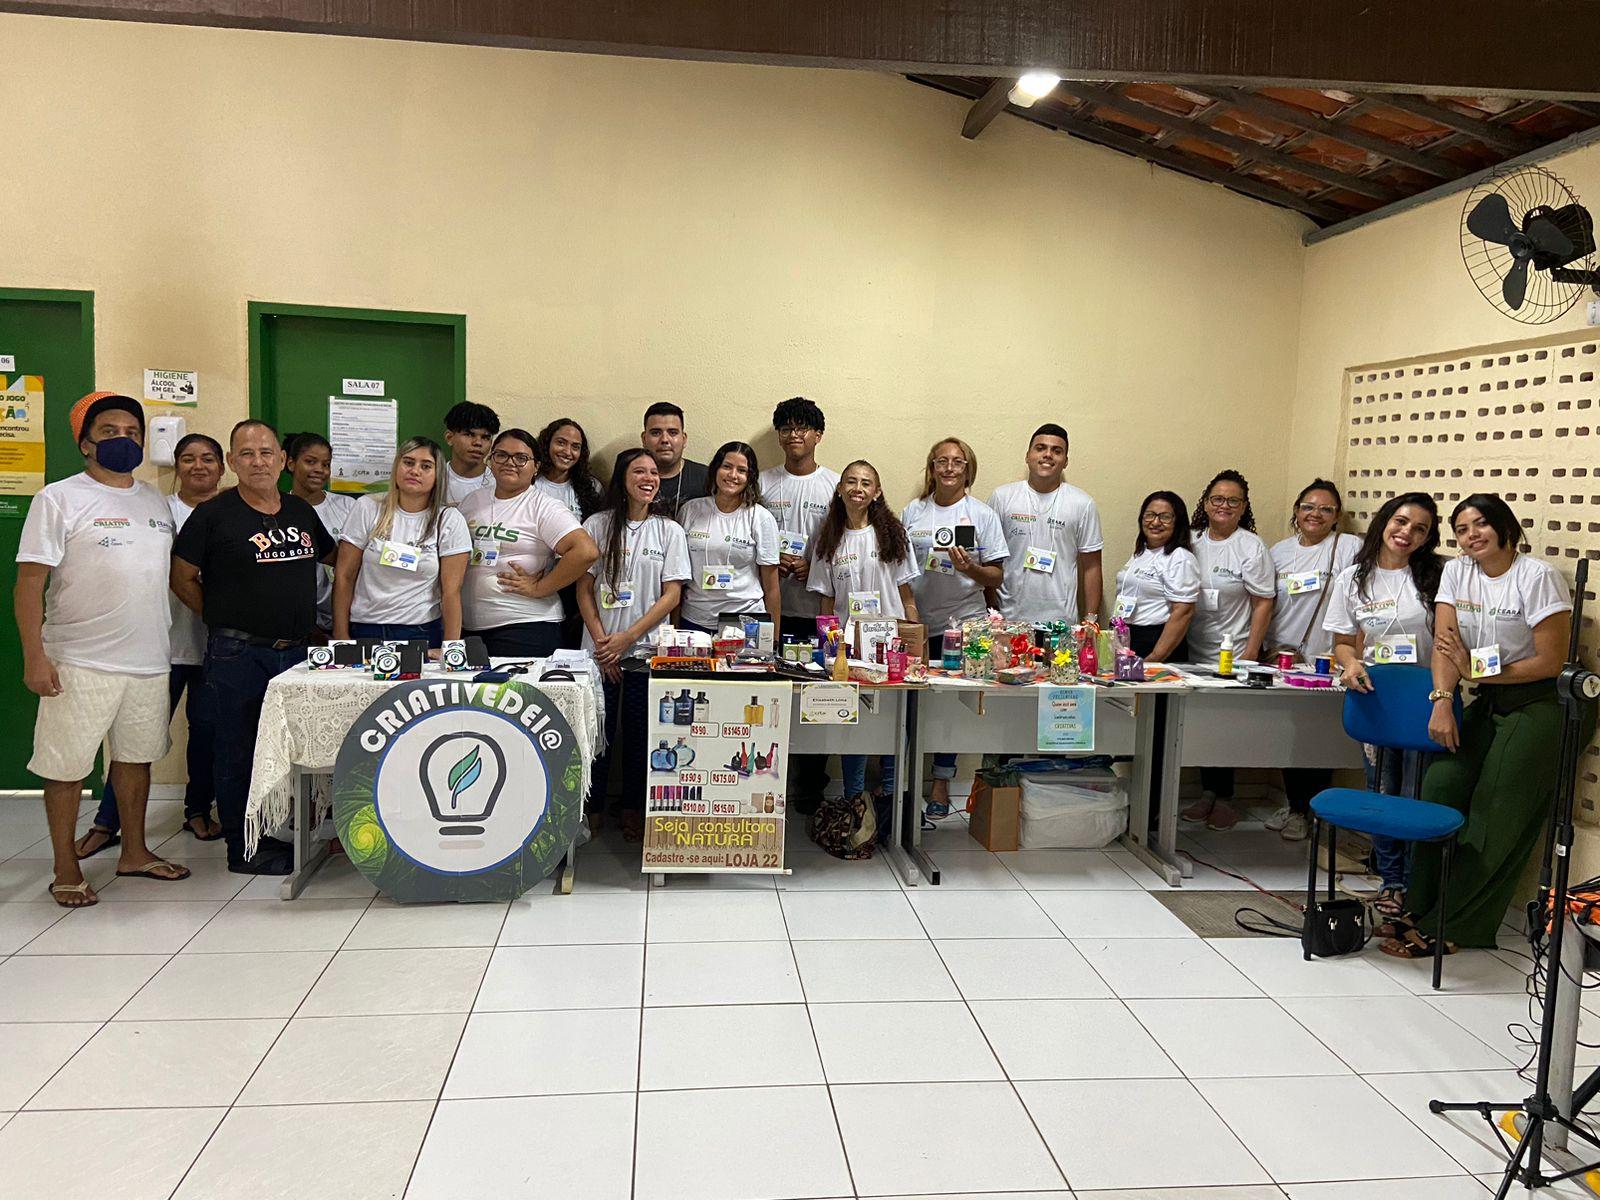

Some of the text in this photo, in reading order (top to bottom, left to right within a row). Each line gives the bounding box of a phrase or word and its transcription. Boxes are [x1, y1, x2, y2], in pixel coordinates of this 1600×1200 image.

[153, 371, 189, 381] HIGIENE
[151, 379, 177, 388] ÁLCOOL
[248, 526, 312, 553] BOSS
[255, 547, 315, 560] HUGO BOSS
[1497, 608, 1521, 616] CEARÁ
[360, 682, 563, 753] CRIATIVEDEI@
[654, 817, 776, 835] Seja consultora
[676, 833, 753, 846] NATURA
[645, 852, 688, 864] Cadastre
[701, 854, 724, 865] aqui:
[725, 853, 759, 868] LOJA
[763, 854, 778, 868] 22
